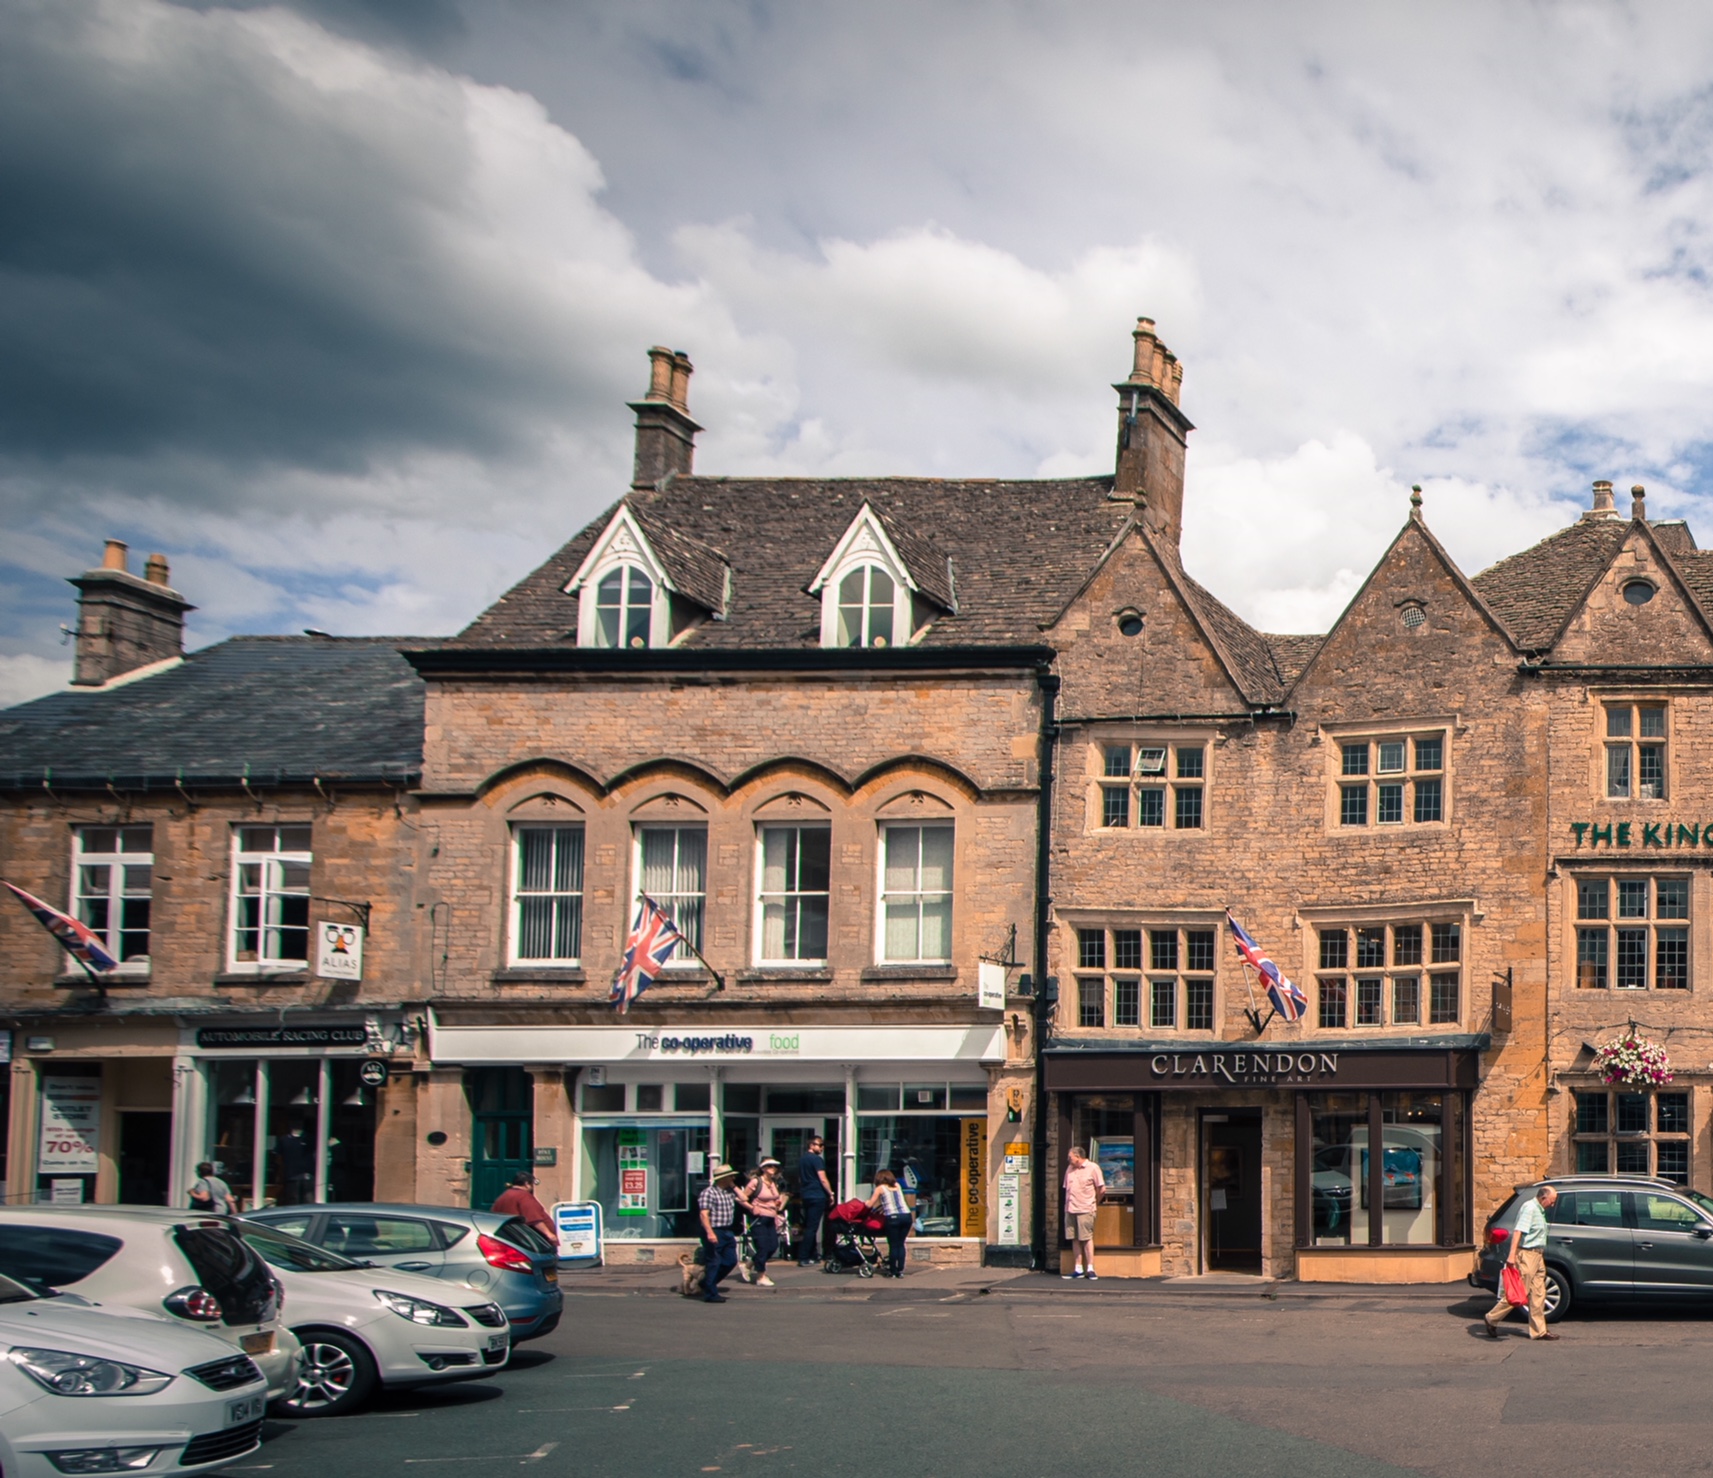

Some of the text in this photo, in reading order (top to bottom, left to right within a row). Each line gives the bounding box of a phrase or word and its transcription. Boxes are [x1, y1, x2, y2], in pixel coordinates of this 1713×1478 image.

[1571, 822, 1631, 847] THE
[322, 957, 358, 970] ALIAS
[201, 1030, 365, 1042] AUTOMOBILE RACING CLUB
[635, 1033, 800, 1055] The co-operative food
[1151, 1053, 1339, 1083] CLARENDON
[50, 1104, 93, 1113] OUTLET
[52, 1112, 89, 1120] STORE
[45, 1140, 95, 1154] 70%
[966, 1122, 982, 1205] co-operative
[966, 1207, 979, 1229] The
